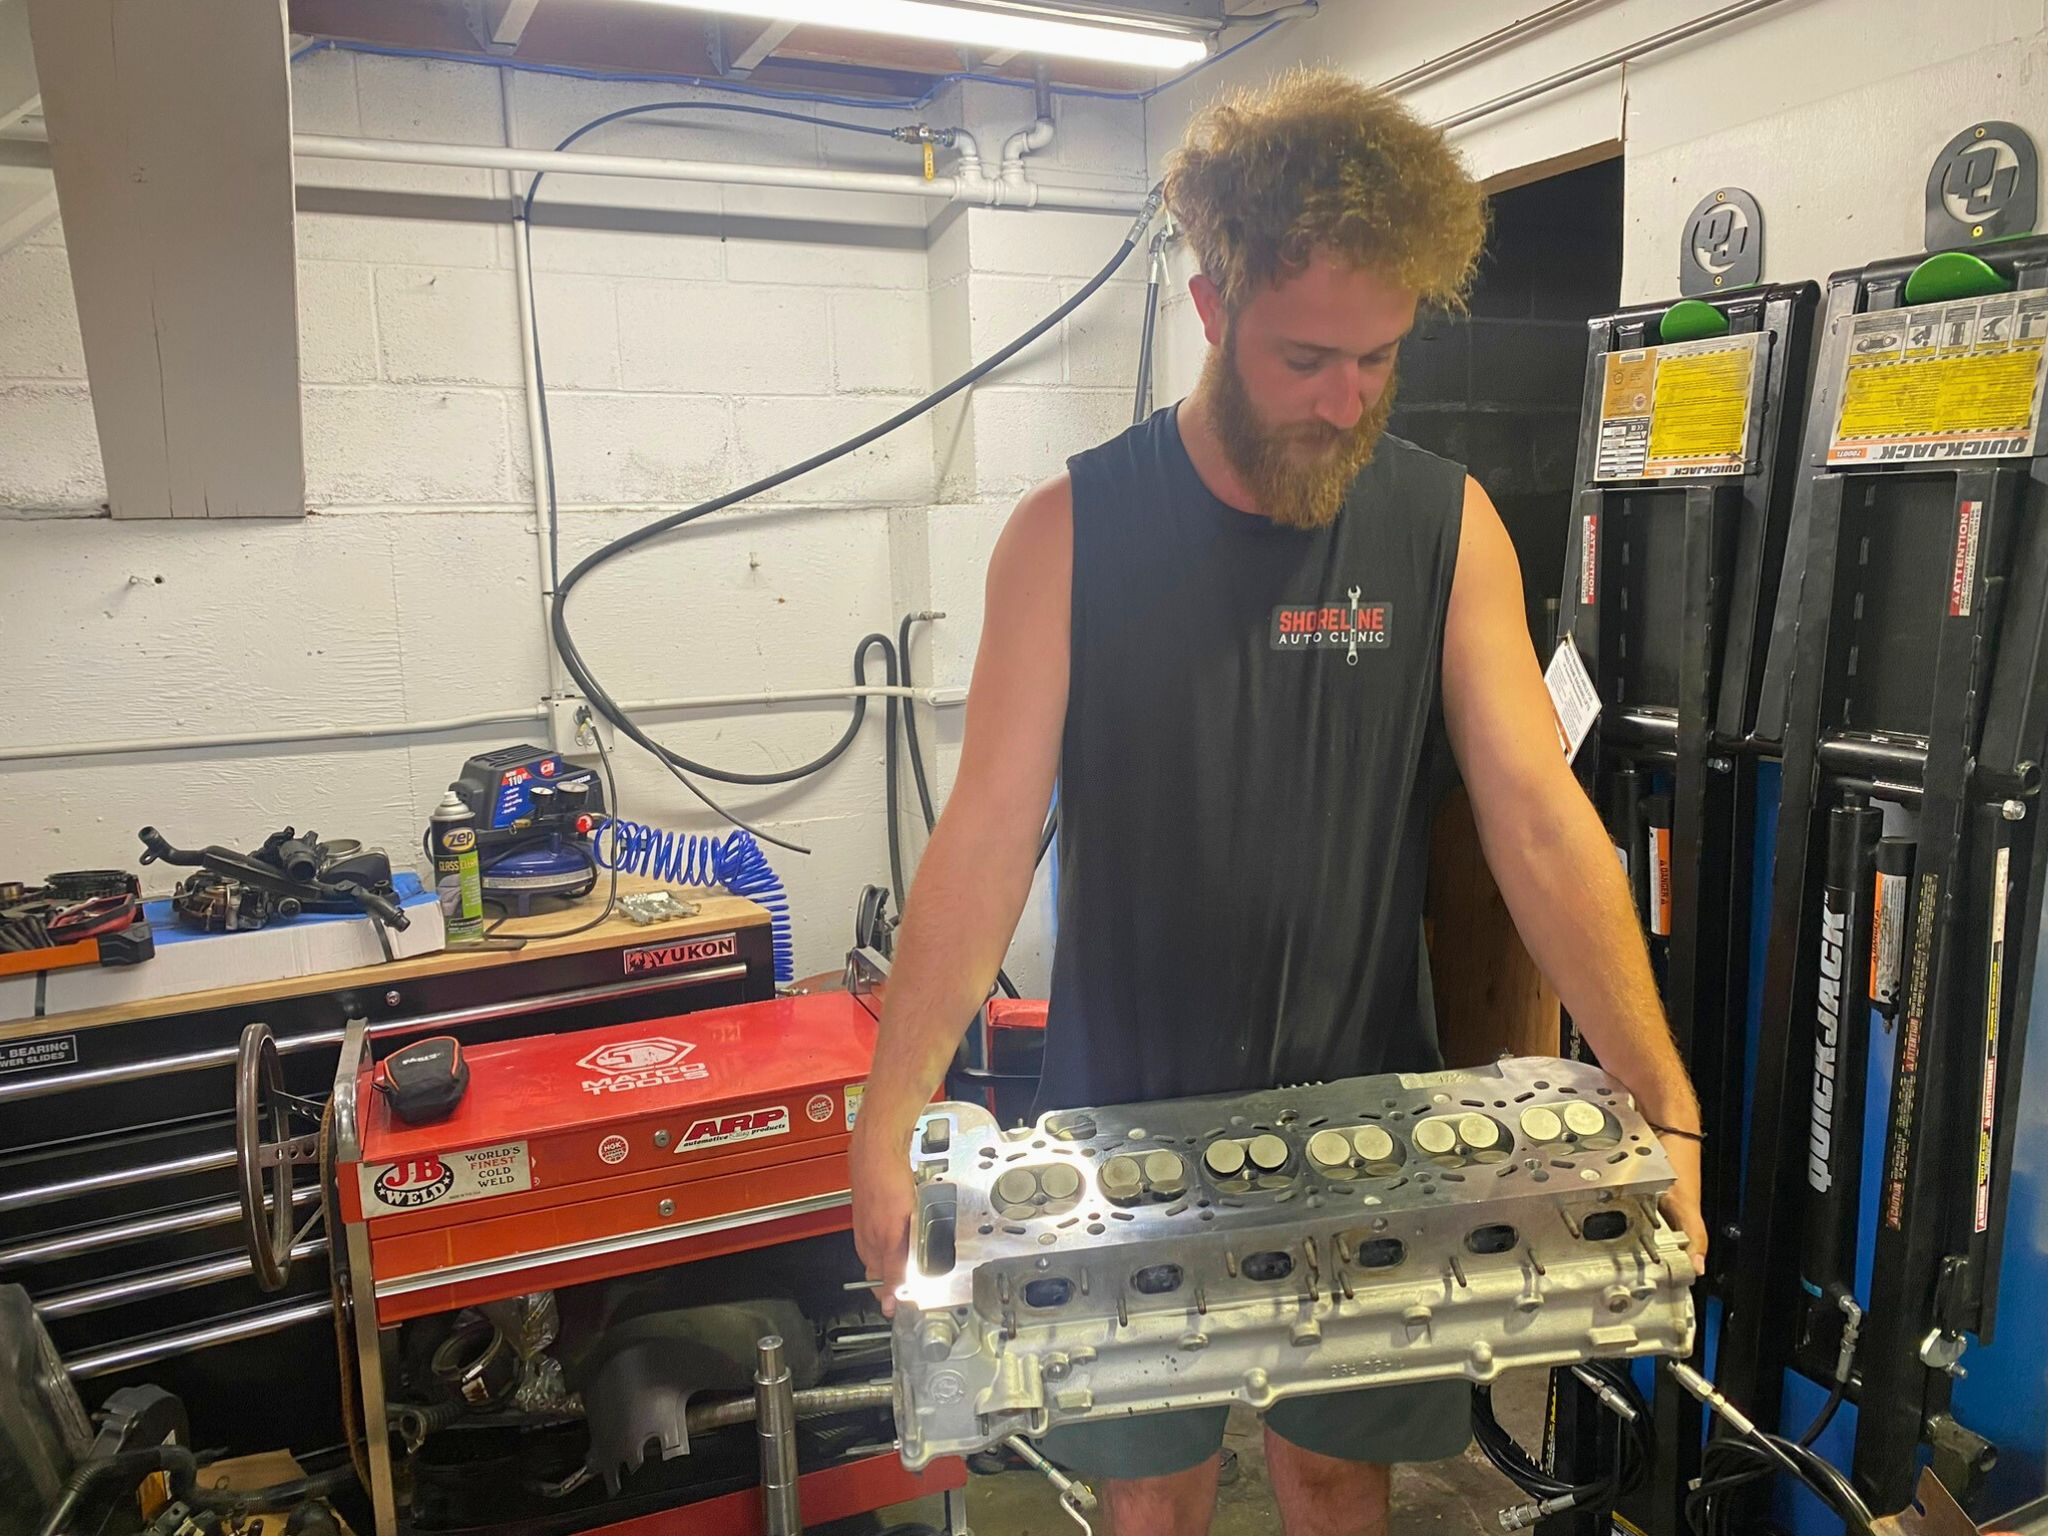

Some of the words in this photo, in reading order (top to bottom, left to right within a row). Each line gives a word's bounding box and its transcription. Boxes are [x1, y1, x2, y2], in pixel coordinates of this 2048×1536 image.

[1879, 437, 2029, 459] QUICKJACK
[1674, 464, 1742, 476] QUICKJACK
[1588, 532, 1596, 595] ATTENTION
[1953, 513, 1969, 591] ATTENTION
[1279, 607, 1385, 632] SHORELINE
[1279, 632, 1323, 644] AUTO
[1329, 632, 1385, 642] CLINIC
[438, 860, 459, 872] GLASS
[1660, 866, 1669, 897] DANGER
[652, 939, 733, 966] YUKON
[9, 1041, 70, 1059] BEARING
[1906, 1018, 1919, 1060] ATTENTION
[26, 1051, 65, 1064] SLIDES
[1808, 911, 1846, 1194] QUICKJACK
[582, 1062, 706, 1090] MATCO
[583, 1070, 710, 1096] TOOLS
[683, 1134, 729, 1147] automotive
[751, 1122, 786, 1135] products
[684, 1108, 785, 1142] ARP
[465, 1146, 521, 1163] WORLD'S
[603, 1140, 622, 1152] NGK
[385, 1154, 443, 1187] J-B
[470, 1156, 516, 1170] FINEST
[478, 1166, 512, 1179] COLD
[385, 1182, 447, 1206] WELD
[477, 1175, 515, 1189] WELD
[1890, 1183, 1902, 1217] CAUTION
